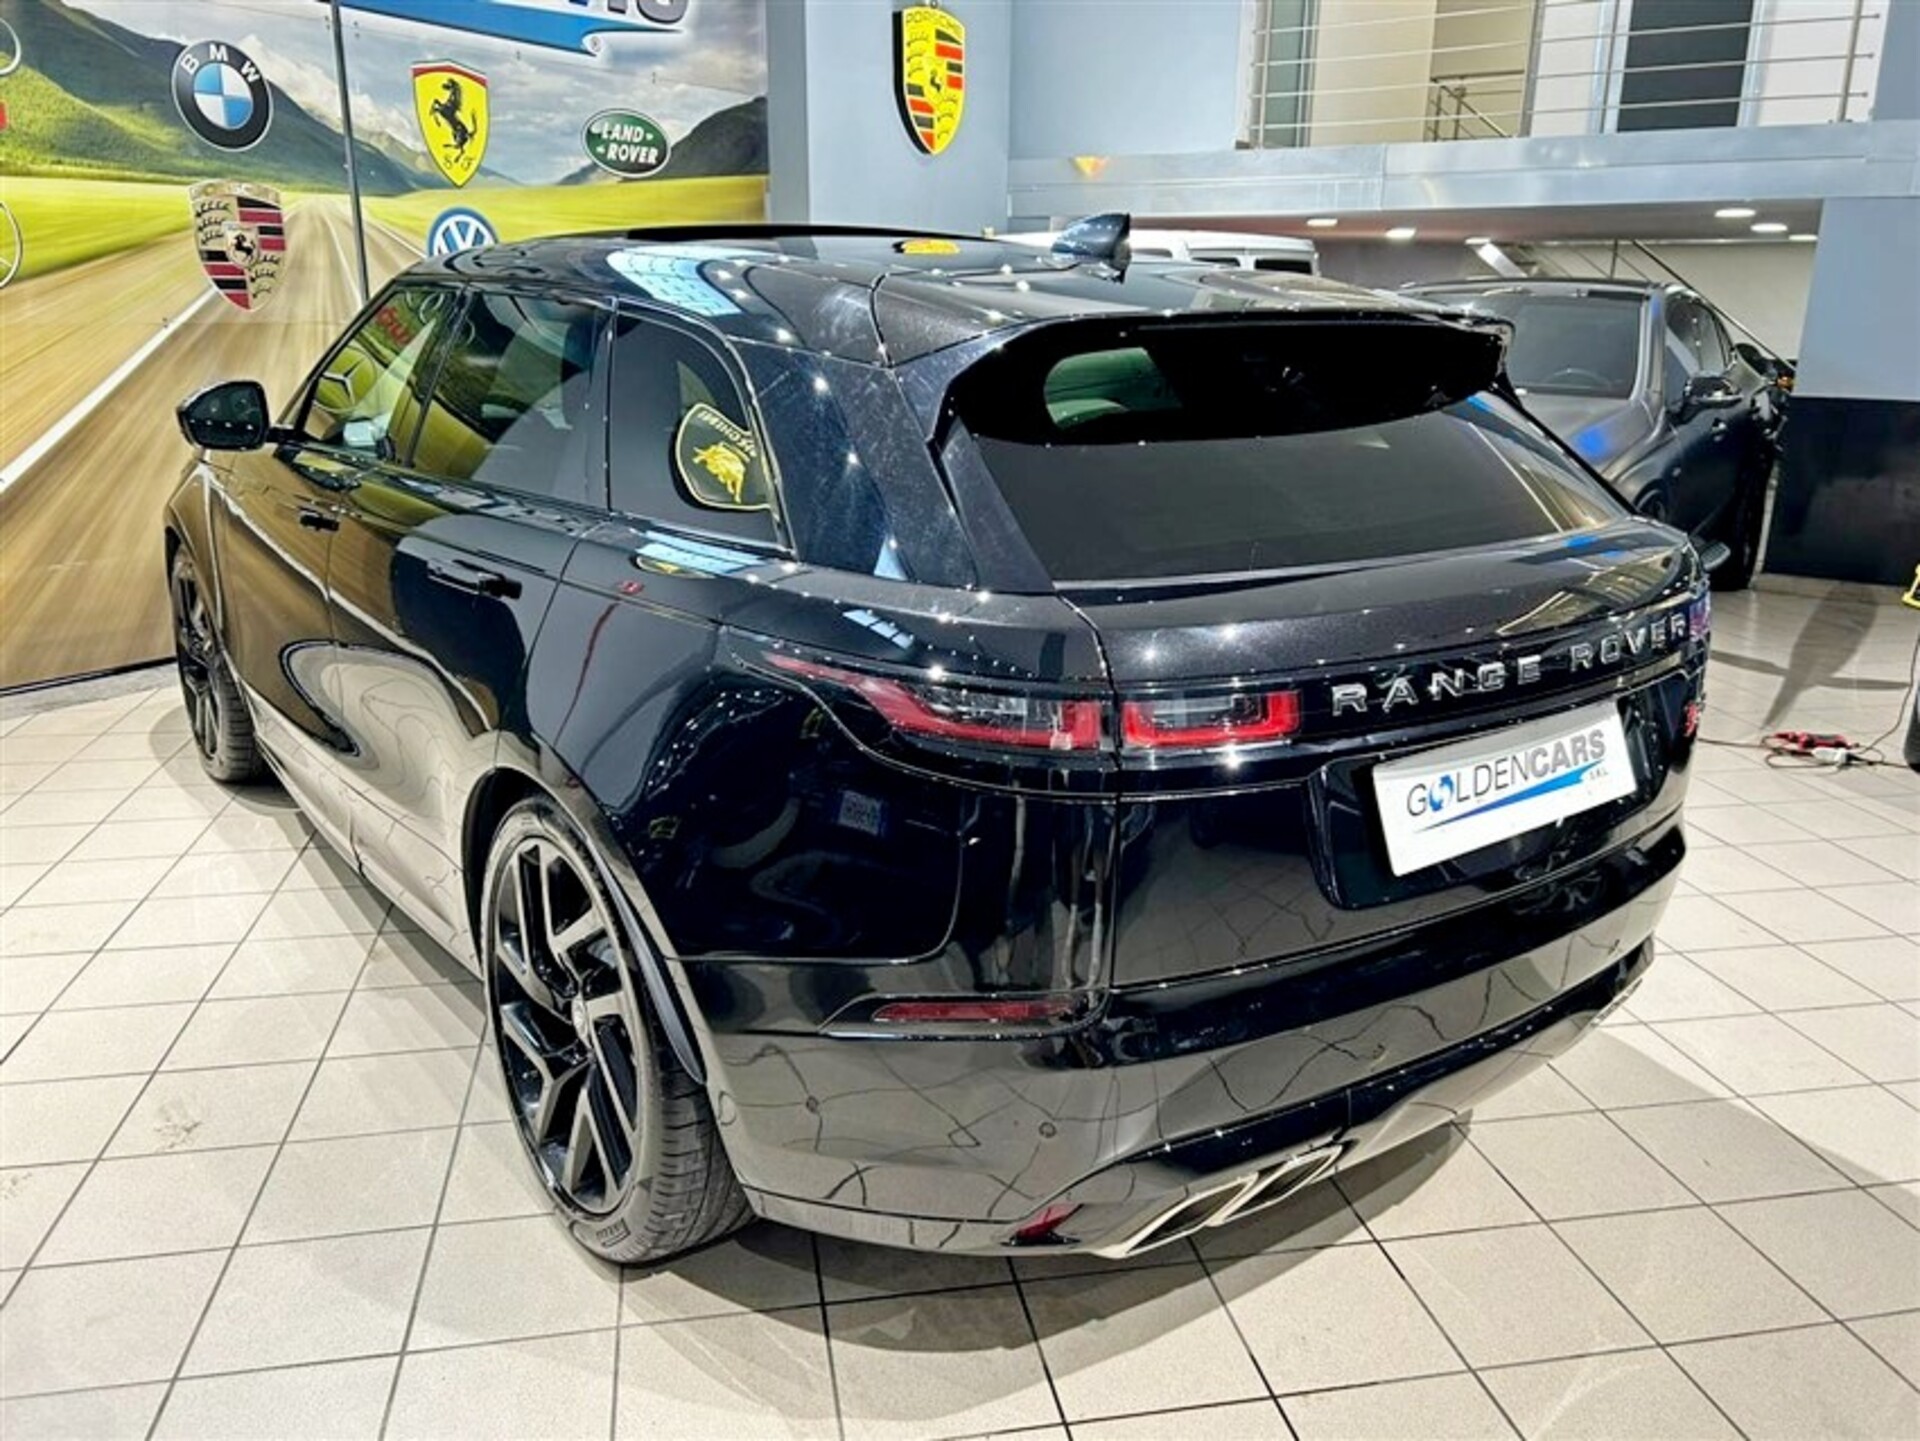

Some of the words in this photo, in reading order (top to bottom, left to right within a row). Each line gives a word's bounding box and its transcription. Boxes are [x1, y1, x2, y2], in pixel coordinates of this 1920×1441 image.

[181, 43, 260, 82] BMW
[602, 122, 645, 143] LAND
[607, 143, 659, 165] ROVER
[1332, 655, 1542, 716] RANGE
[1570, 612, 1686, 672] ROVER
[1407, 729, 1606, 816] GOLDENCARS
